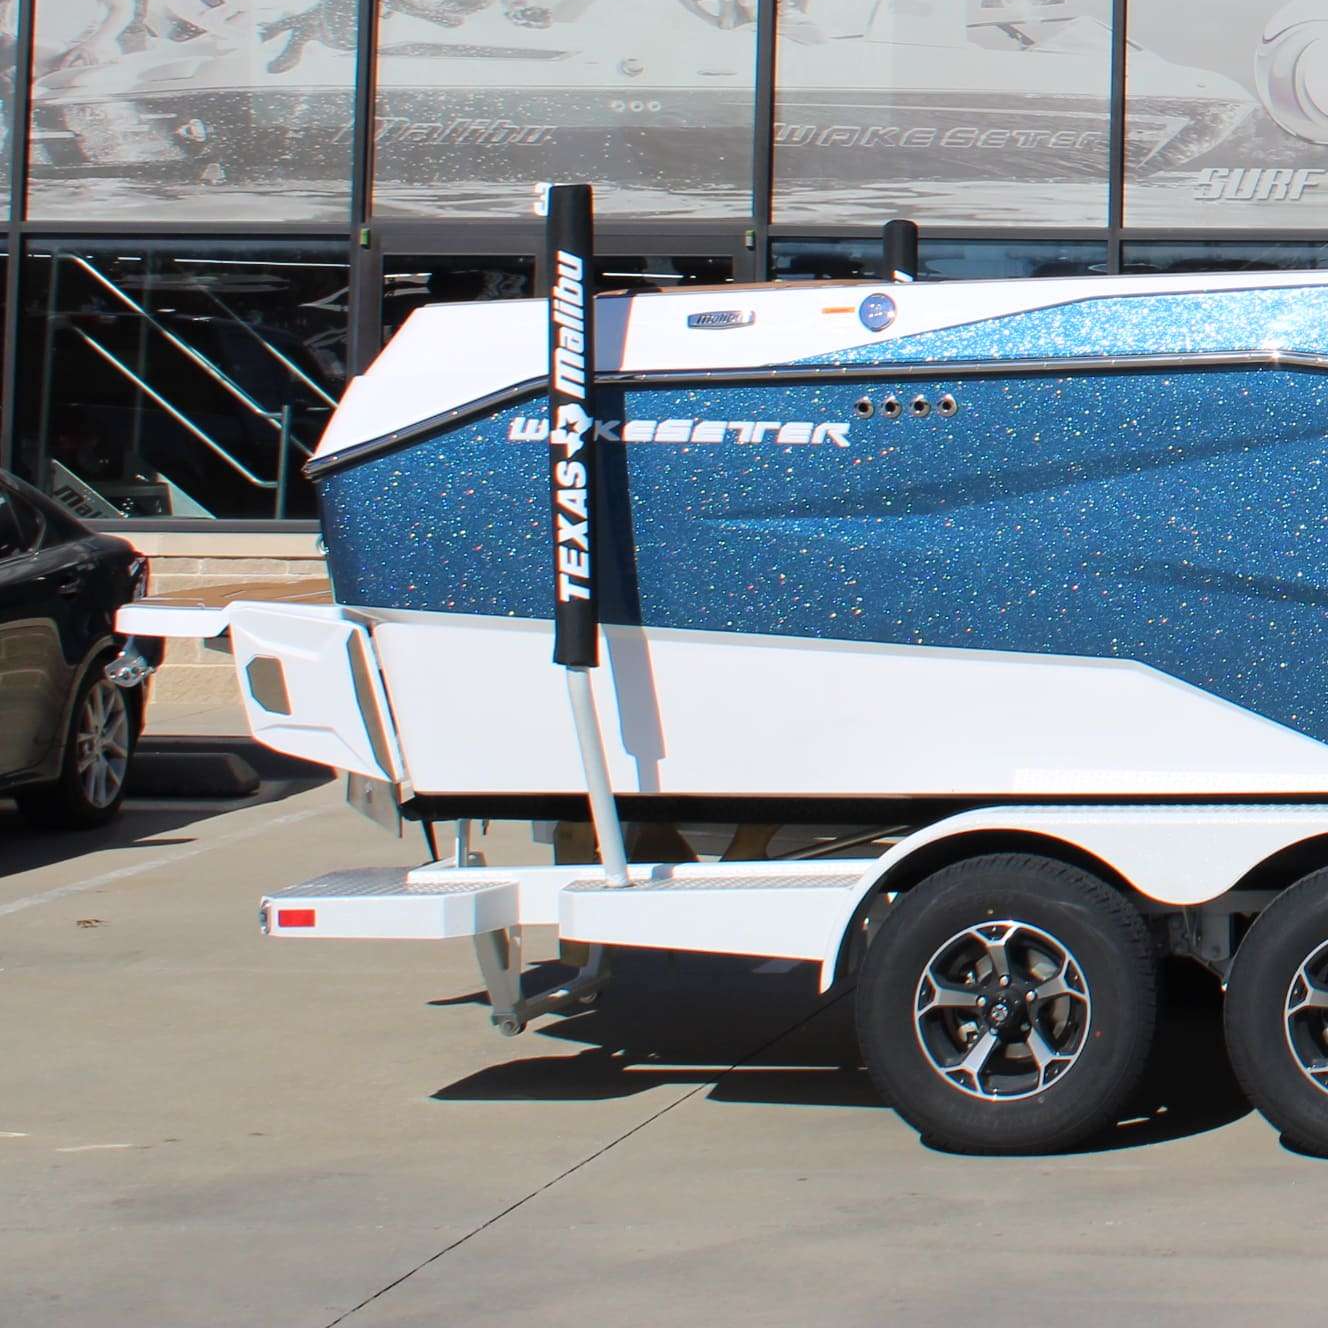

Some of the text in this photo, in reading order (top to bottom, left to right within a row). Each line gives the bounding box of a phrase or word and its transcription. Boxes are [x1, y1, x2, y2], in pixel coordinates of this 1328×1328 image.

[1193, 168, 1325, 201] SURF
[508, 416, 851, 448] WKESETTER
[552, 249, 591, 603] TEXAS Malibu
